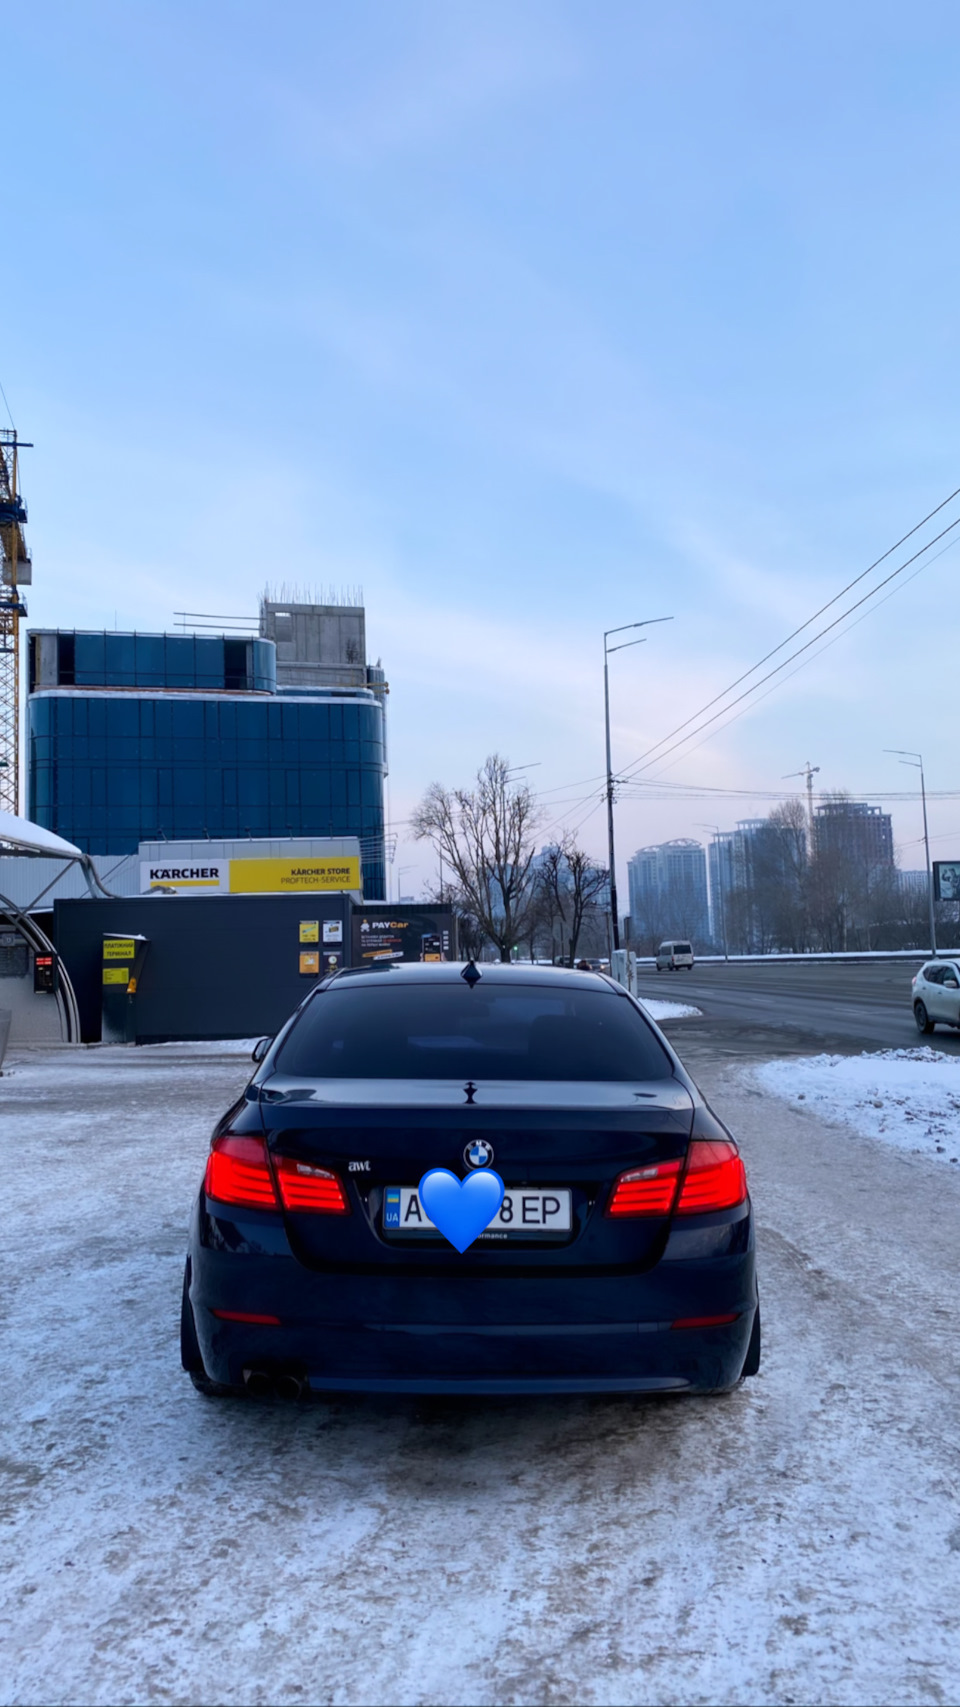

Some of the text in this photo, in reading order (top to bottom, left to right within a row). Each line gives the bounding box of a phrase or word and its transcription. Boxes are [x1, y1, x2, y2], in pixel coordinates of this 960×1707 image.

[150, 868, 219, 879] KÄRCHER
[327, 867, 350, 875] STORE
[281, 876, 351, 884] PROFTECH-SERVICE
[372, 921, 409, 929] PAYCar
[499, 1196, 514, 1223] 8
[522, 1196, 561, 1224] EP
[386, 1212, 399, 1222] UA
[478, 1232, 508, 1240] ormance
